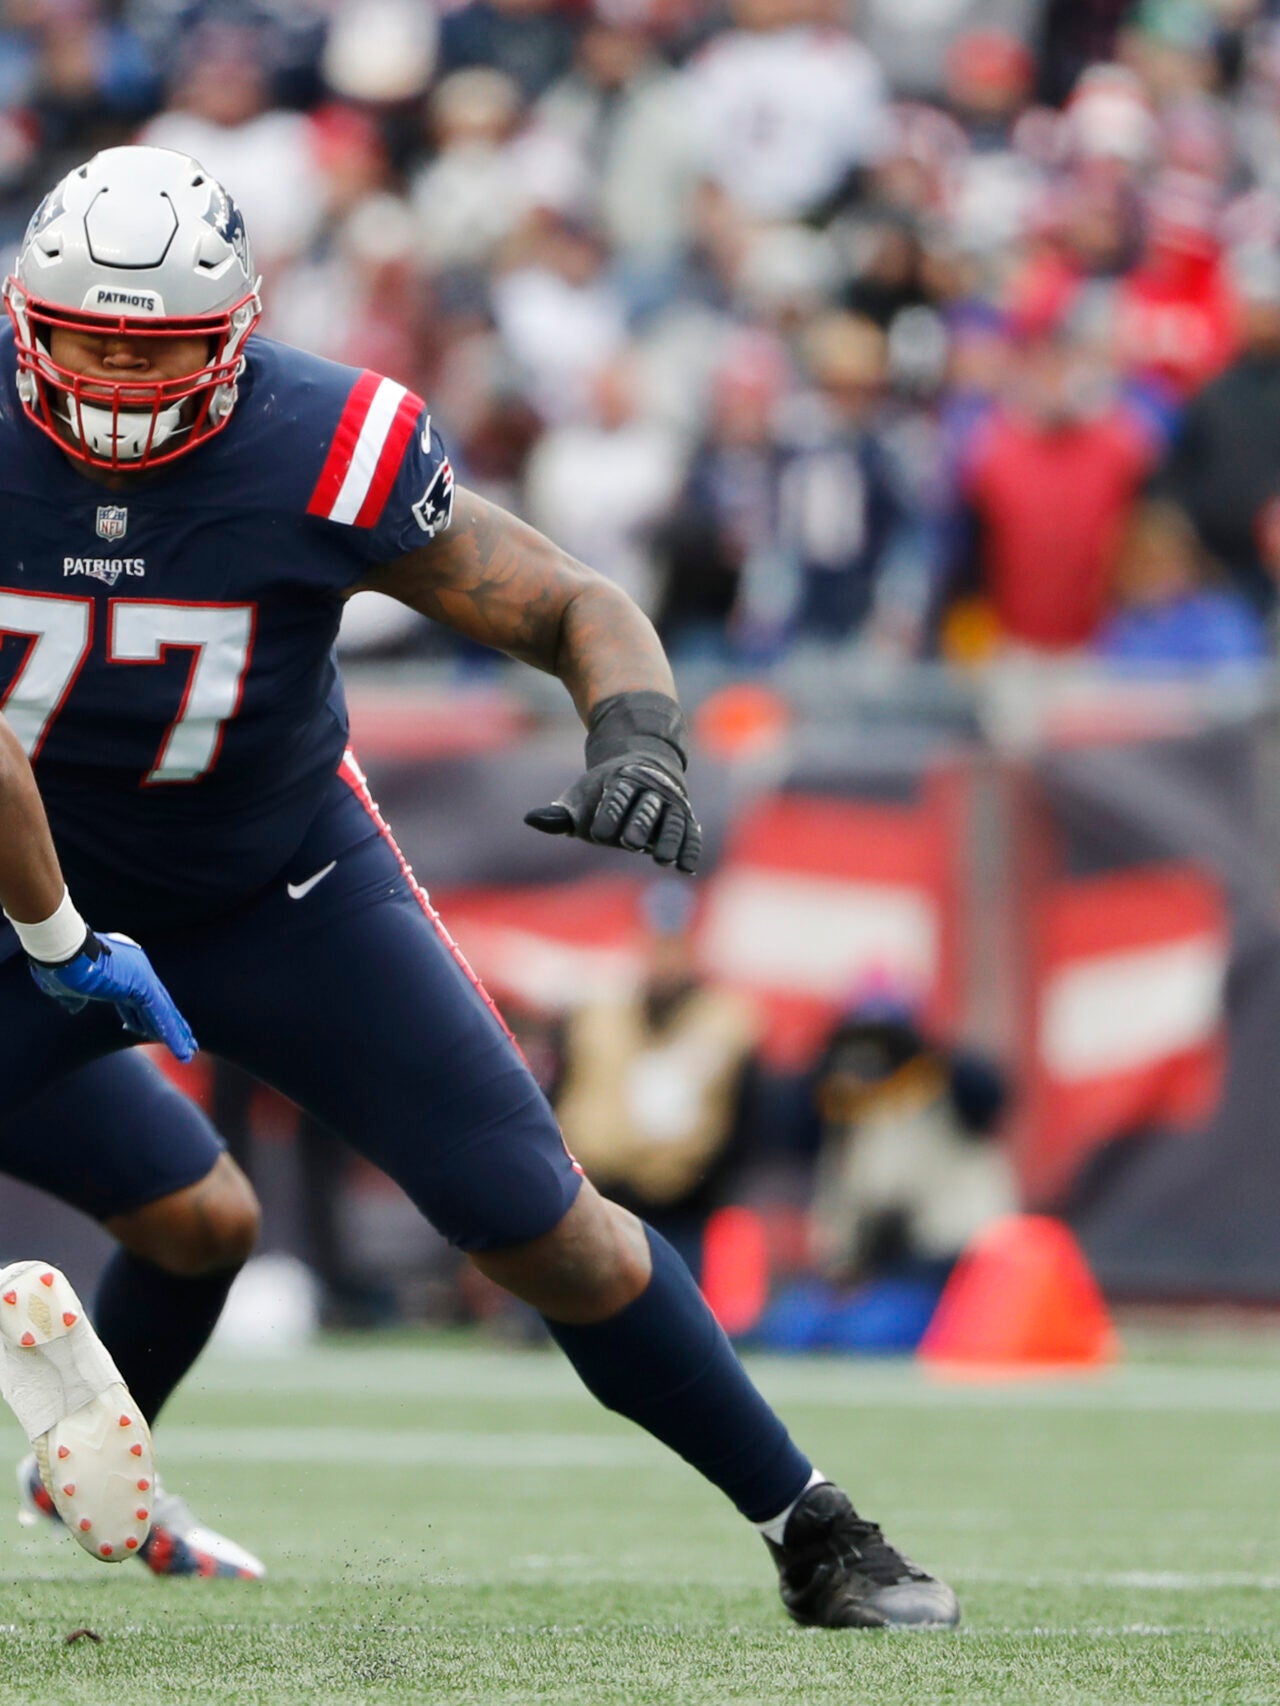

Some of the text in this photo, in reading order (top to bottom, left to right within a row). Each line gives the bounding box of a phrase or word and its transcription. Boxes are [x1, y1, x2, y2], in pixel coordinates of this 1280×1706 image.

[97, 290, 155, 312] PATRIOTS
[101, 520, 122, 535] NFL
[63, 557, 145, 577] PATRIOTS
